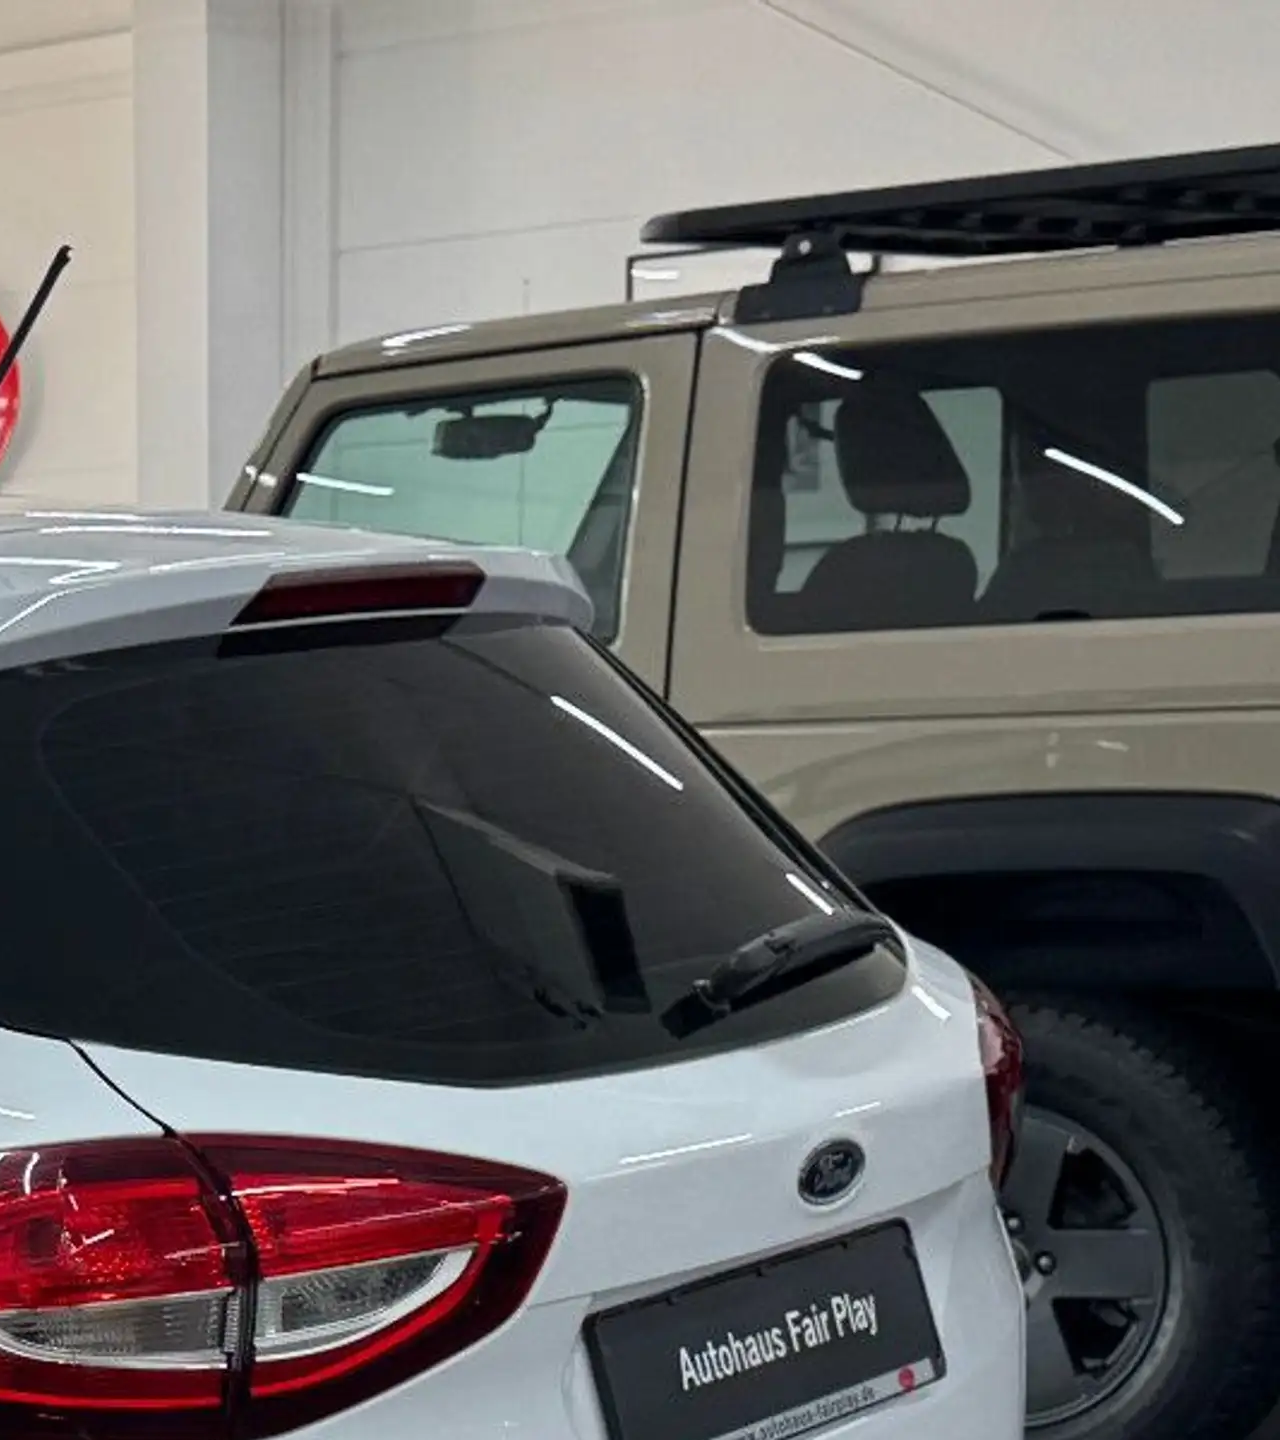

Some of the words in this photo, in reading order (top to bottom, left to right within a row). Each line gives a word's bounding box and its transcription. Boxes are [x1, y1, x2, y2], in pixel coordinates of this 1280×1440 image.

[679, 1331, 787, 1391] Autohaus
[784, 1303, 831, 1353] Fair
[831, 1292, 878, 1336] Play
